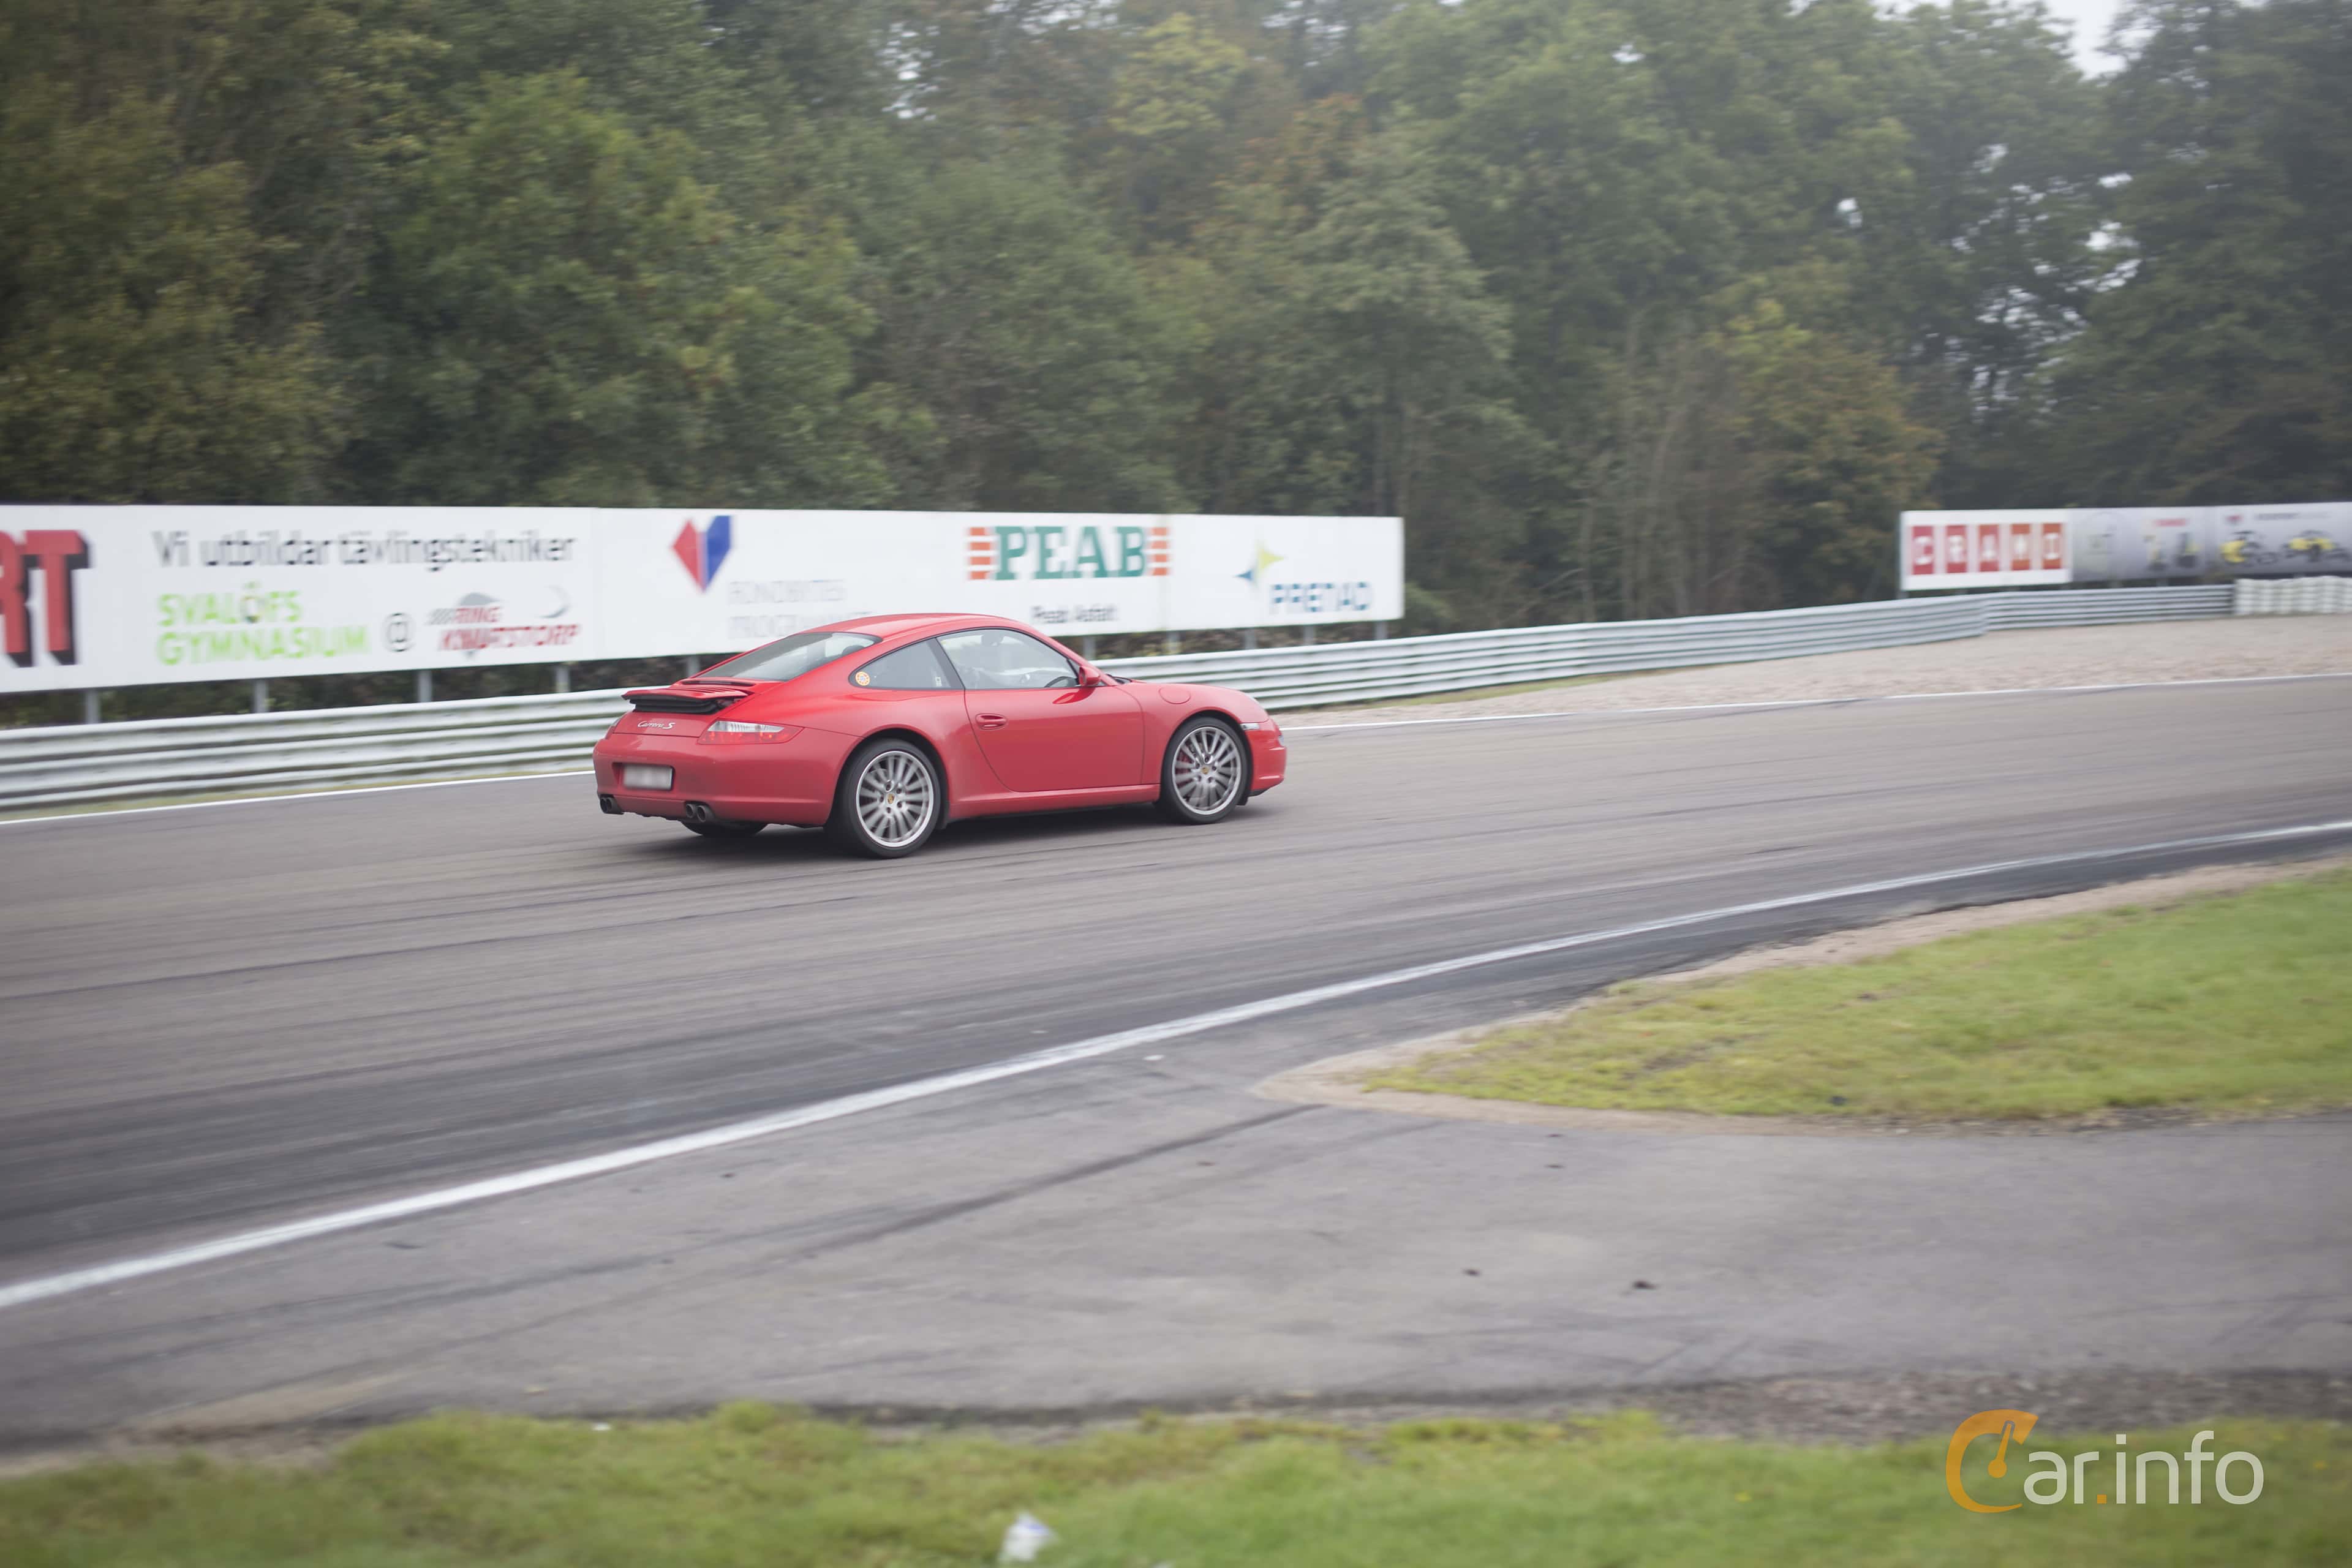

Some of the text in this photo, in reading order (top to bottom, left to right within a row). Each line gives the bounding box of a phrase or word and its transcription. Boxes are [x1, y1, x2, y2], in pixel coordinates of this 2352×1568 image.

[152, 530, 189, 567] Vi
[199, 529, 332, 567] utbildar
[995, 526, 1147, 580] PEAB
[156, 625, 371, 665] GYMNASIUM
